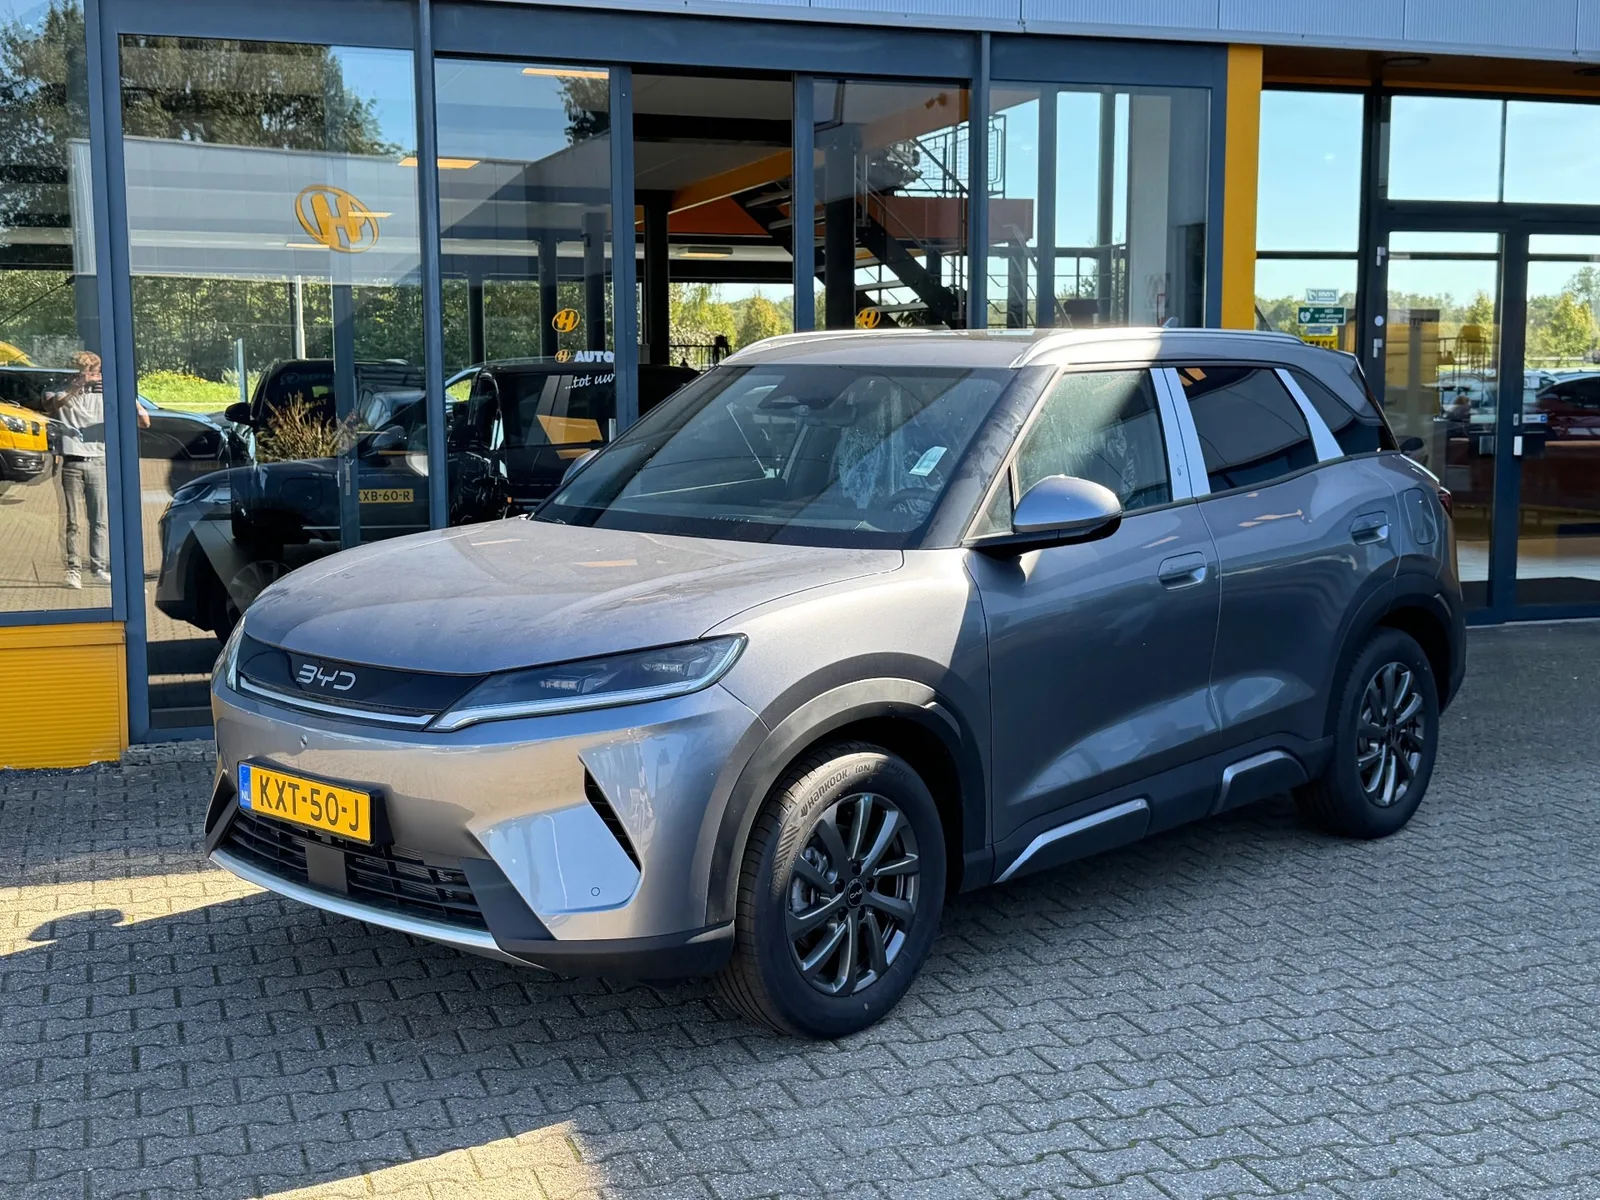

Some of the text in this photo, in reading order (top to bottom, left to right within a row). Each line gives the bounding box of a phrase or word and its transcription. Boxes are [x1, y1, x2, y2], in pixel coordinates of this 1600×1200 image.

[296, 664, 356, 691] BYD
[241, 774, 360, 832] NL KXT-50-J
